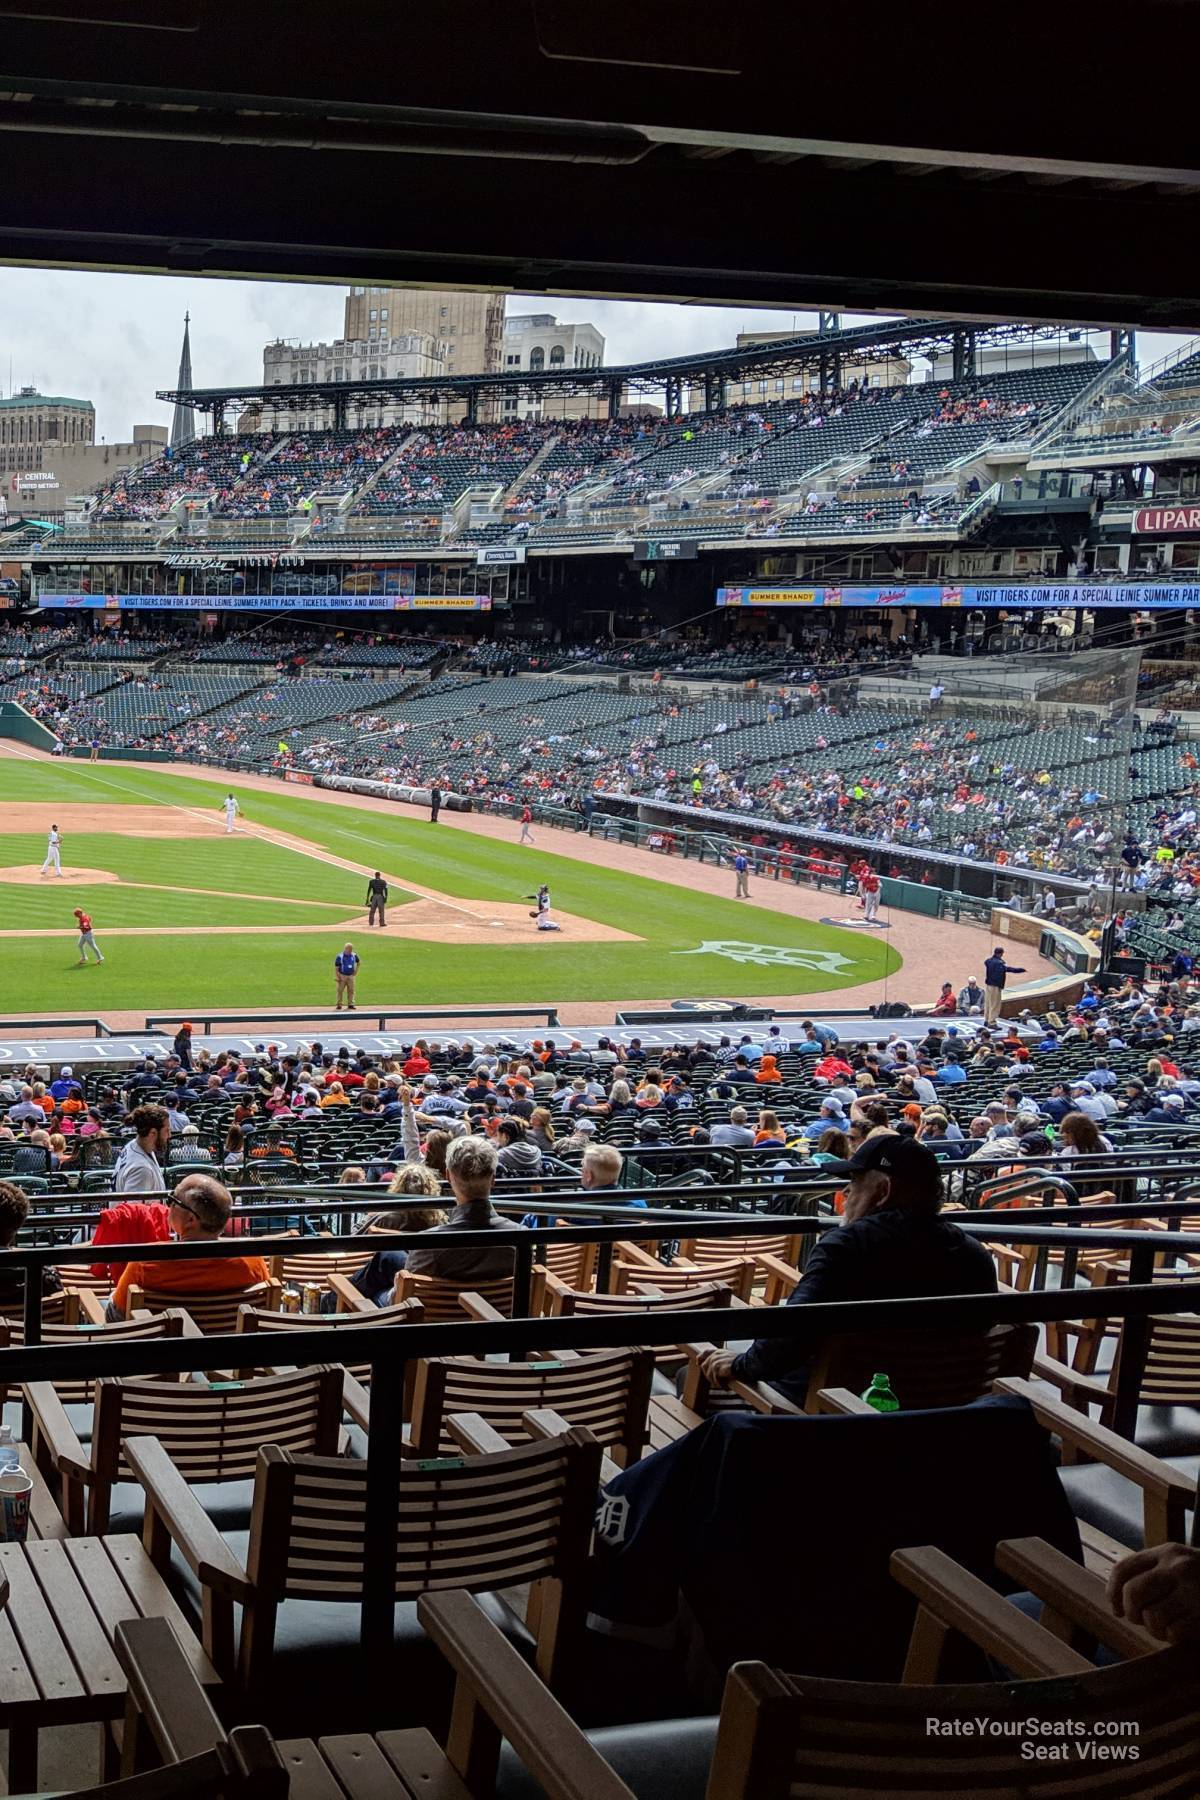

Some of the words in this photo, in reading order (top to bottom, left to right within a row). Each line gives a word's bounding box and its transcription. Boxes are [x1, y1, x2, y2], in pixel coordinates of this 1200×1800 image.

[25, 472, 56, 480] CENTRAL
[1144, 510, 1200, 529] LIPAR
[238, 556, 269, 567] TIGER
[279, 556, 305, 567] CLUB
[976, 590, 997, 601] VISIT
[1001, 590, 1050, 601] TIGERS.COM
[1053, 589, 1070, 601] FOR
[1072, 590, 1079, 601] A
[1082, 589, 1113, 601] SPECIAL
[1115, 589, 1141, 601] LEINIE
[1148, 588, 1180, 600] SUMMER
[125, 598, 138, 606] VISIT
[173, 598, 184, 606] FOR
[185, 598, 189, 606] A
[191, 598, 212, 607] SPECIAL
[214, 598, 232, 607] LEINIE
[234, 598, 258, 607] SUMMER
[260, 598, 279, 607] PARTY
[280, 598, 296, 607] PACK
[330, 598, 352, 607] DRINKS
[354, 598, 367, 607] AND
[238, 1034, 529, 1052] DETROIT
[544, 1028, 768, 1048] TIGERS
